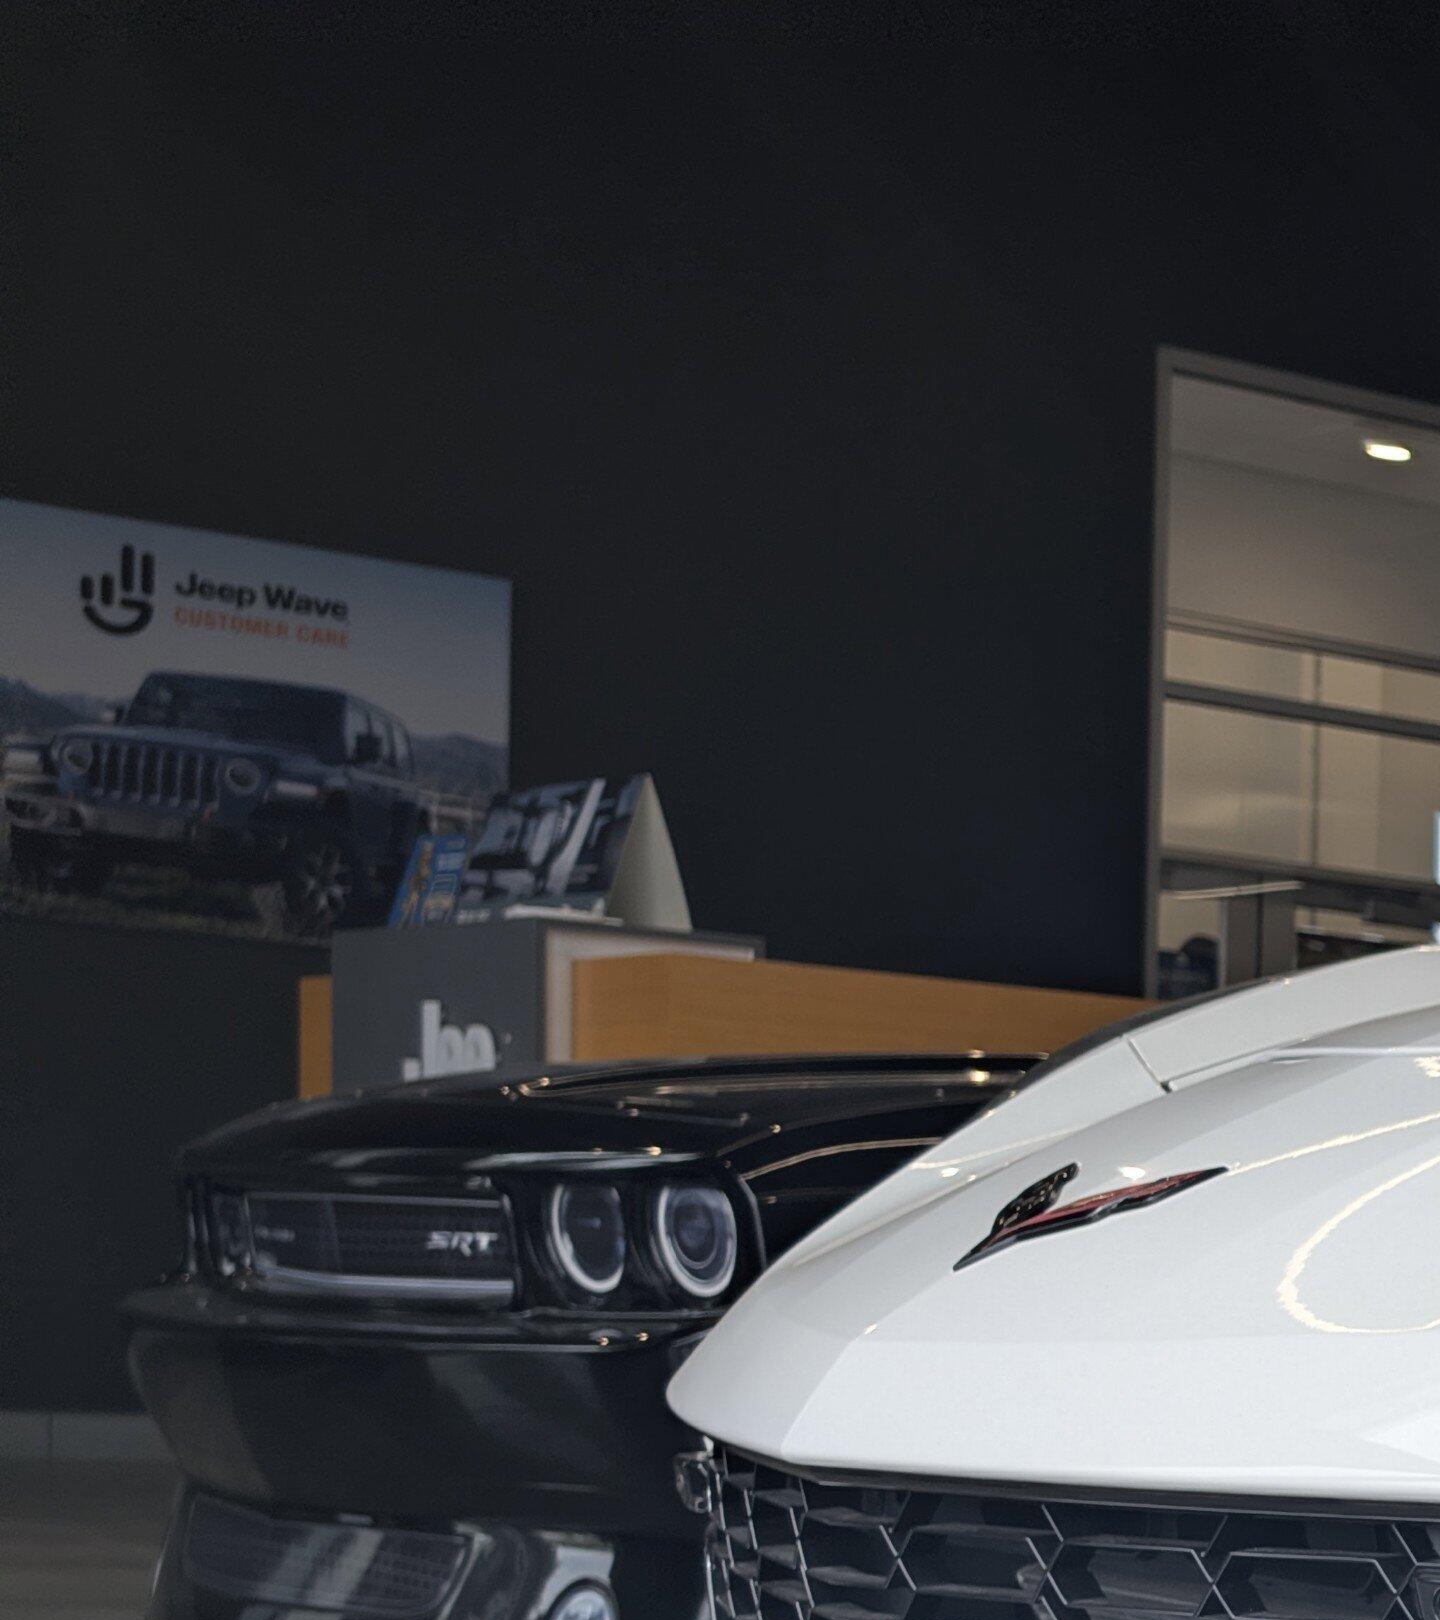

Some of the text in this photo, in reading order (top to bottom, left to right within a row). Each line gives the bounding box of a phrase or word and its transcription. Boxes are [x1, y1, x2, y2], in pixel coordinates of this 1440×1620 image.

[174, 572, 348, 621] Jeep Wave
[173, 605, 349, 648] CUSTOMER CARE
[425, 1230, 499, 1257] SRT
